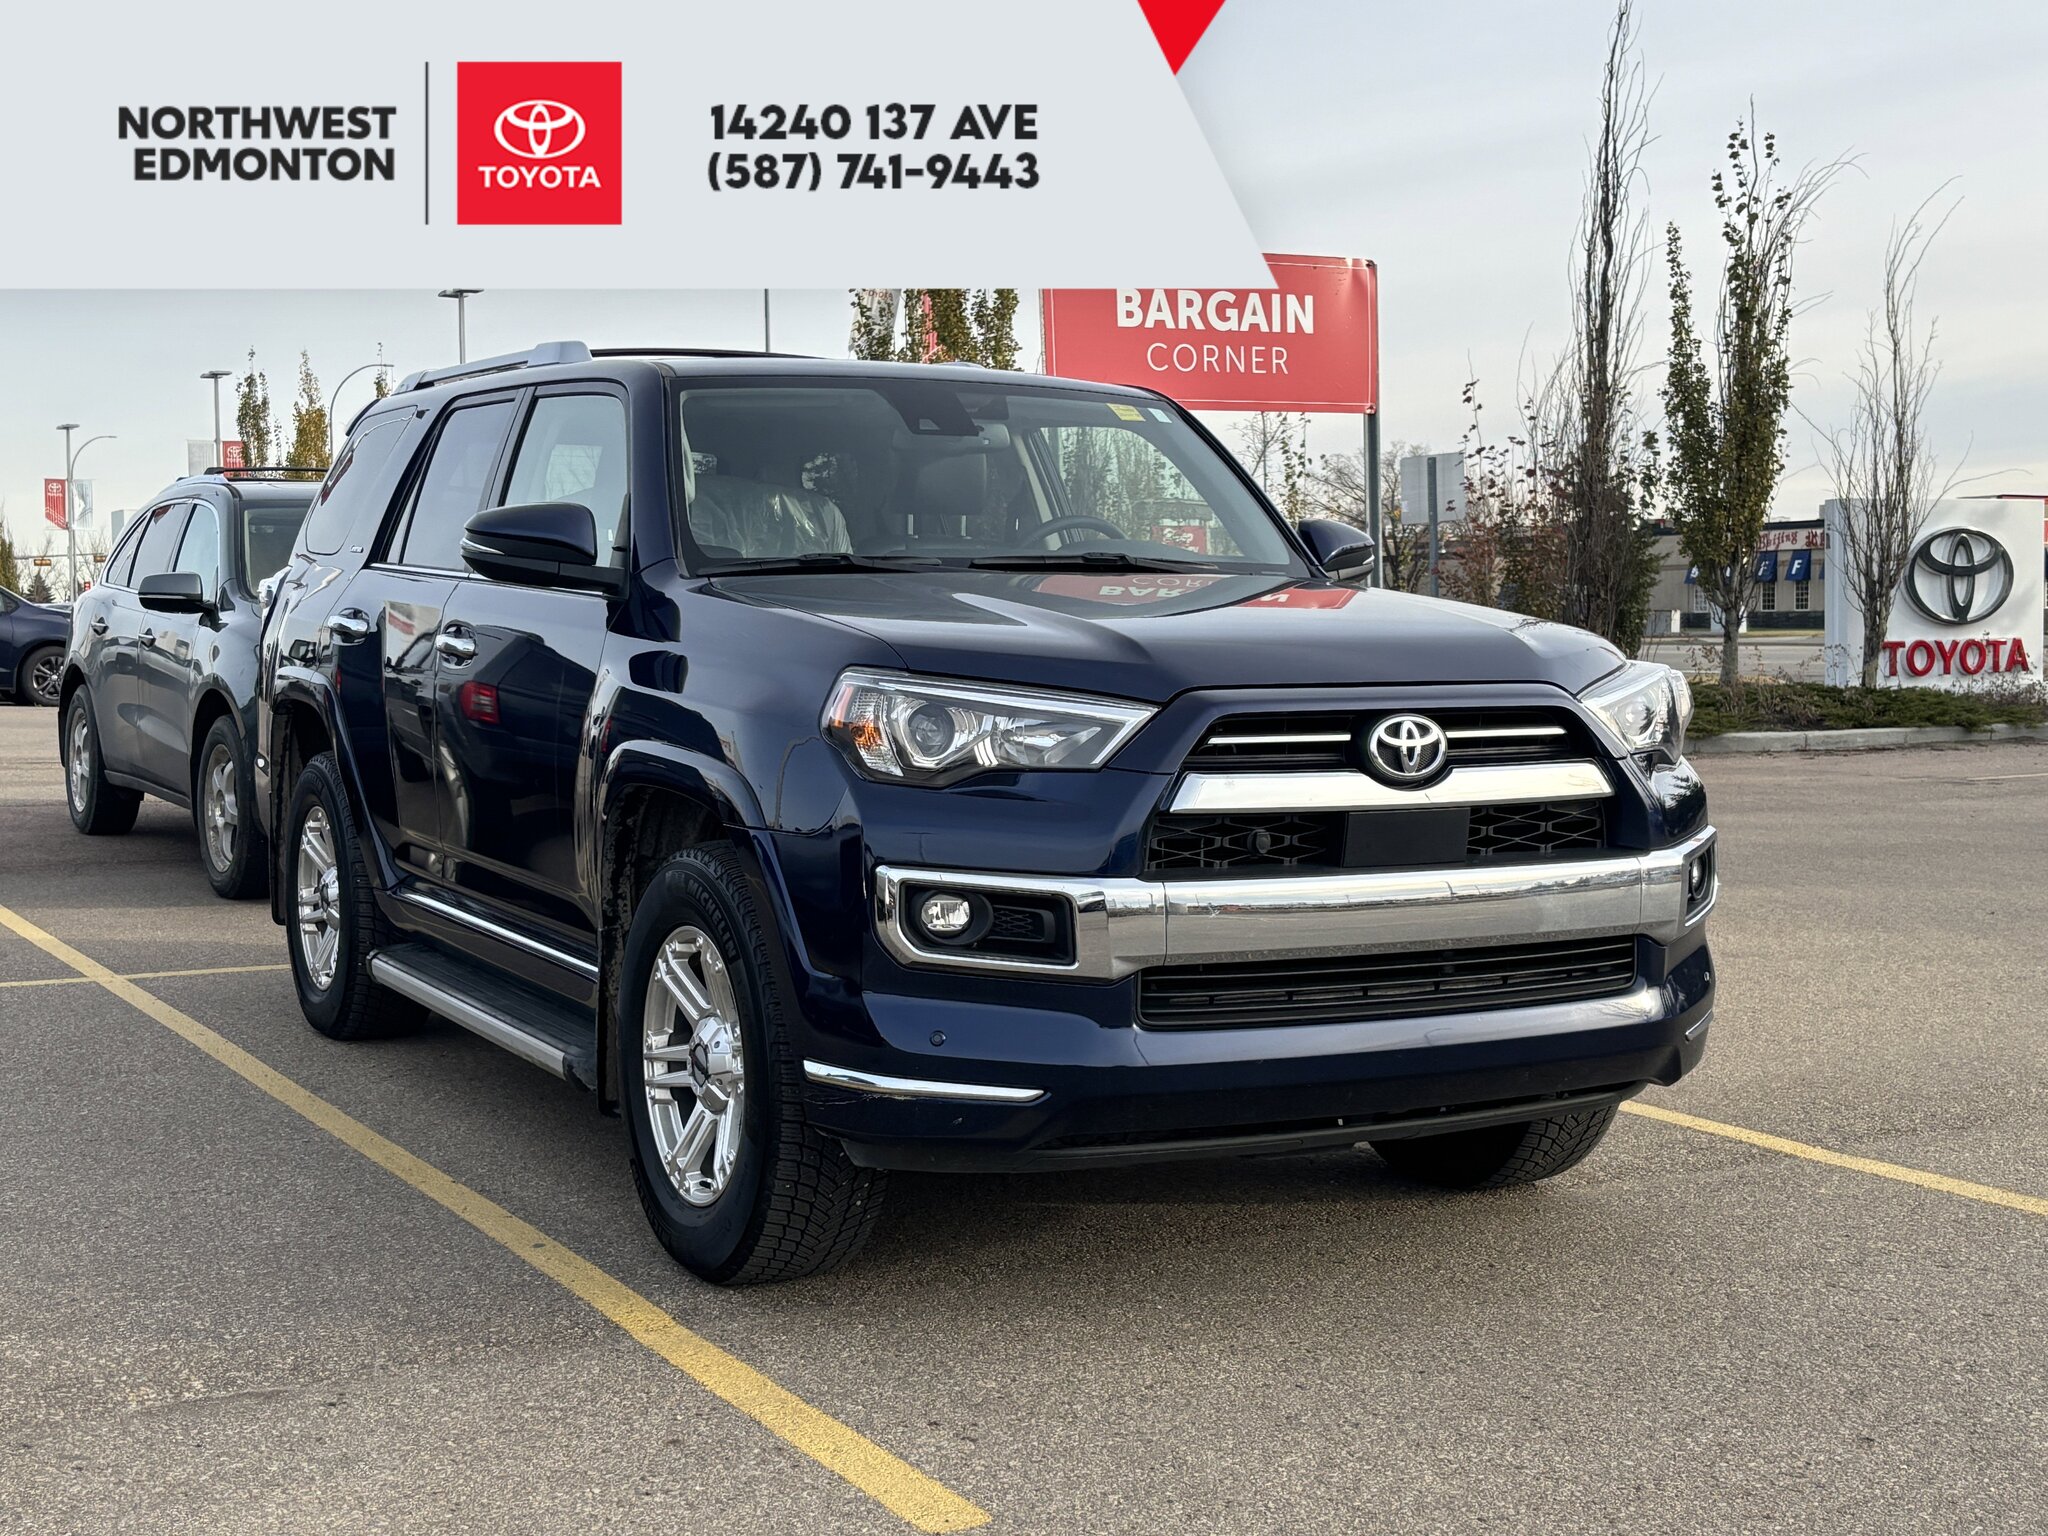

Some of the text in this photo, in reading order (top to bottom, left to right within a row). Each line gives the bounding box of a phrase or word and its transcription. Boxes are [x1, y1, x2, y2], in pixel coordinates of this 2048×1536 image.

[1116, 289, 1314, 334] BARGAIN
[1147, 342, 1289, 375] CORNER
[1881, 637, 2030, 677] TOYOTA
[686, 879, 737, 960] MICHELIN
